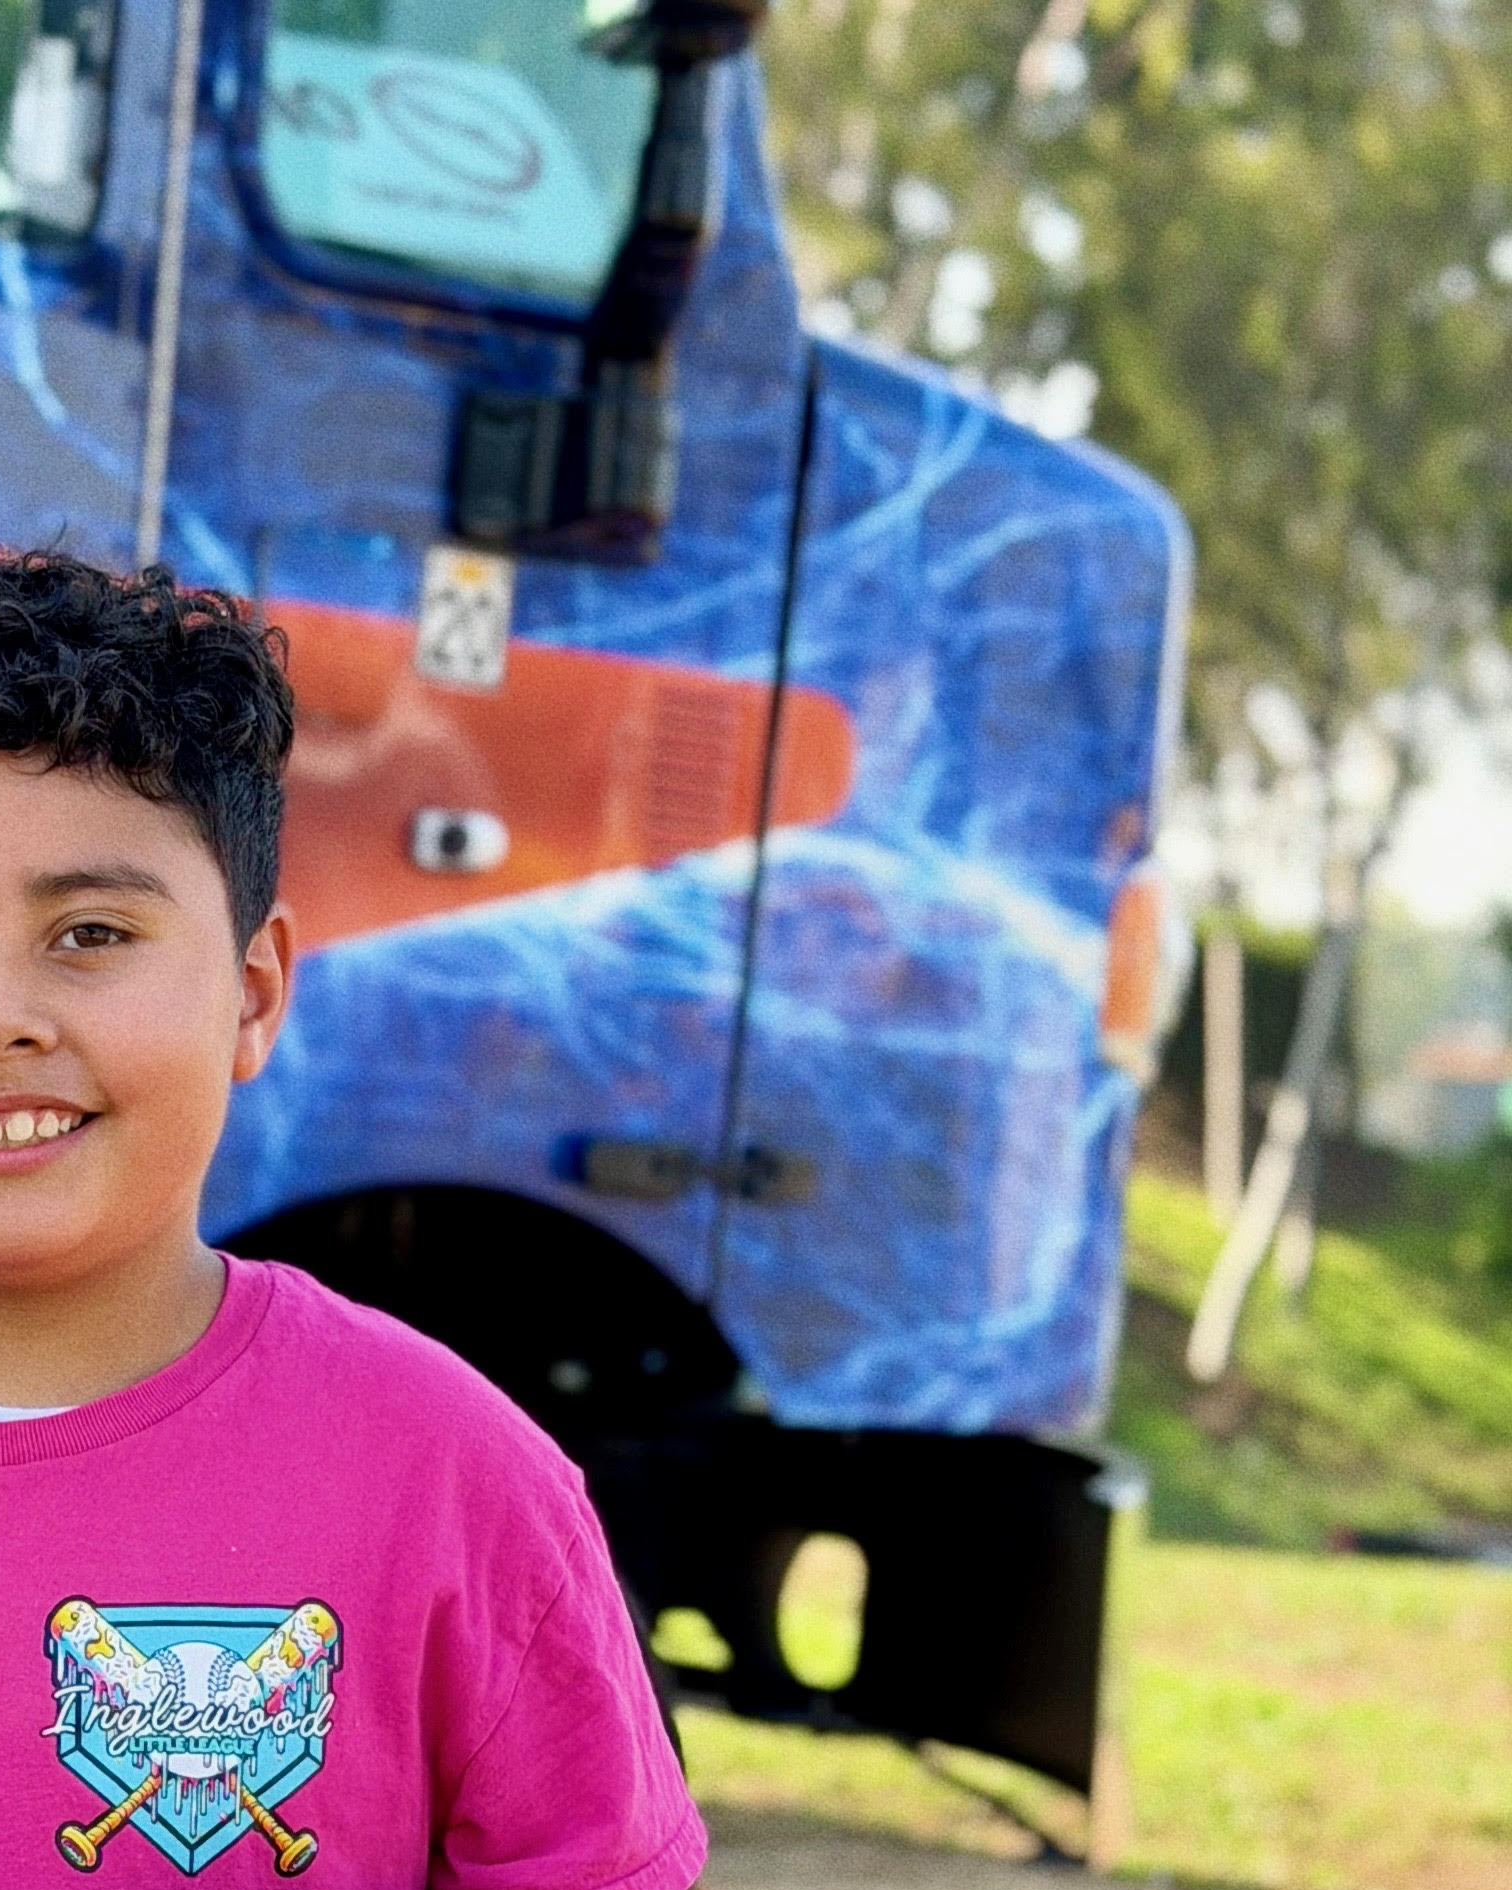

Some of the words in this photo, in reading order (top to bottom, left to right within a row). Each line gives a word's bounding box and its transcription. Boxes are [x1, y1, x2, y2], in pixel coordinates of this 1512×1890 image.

[41, 1684, 335, 1755] Inglewood
[129, 1736, 186, 1753] LITTLE
[188, 1737, 256, 1756] LEAGUE
